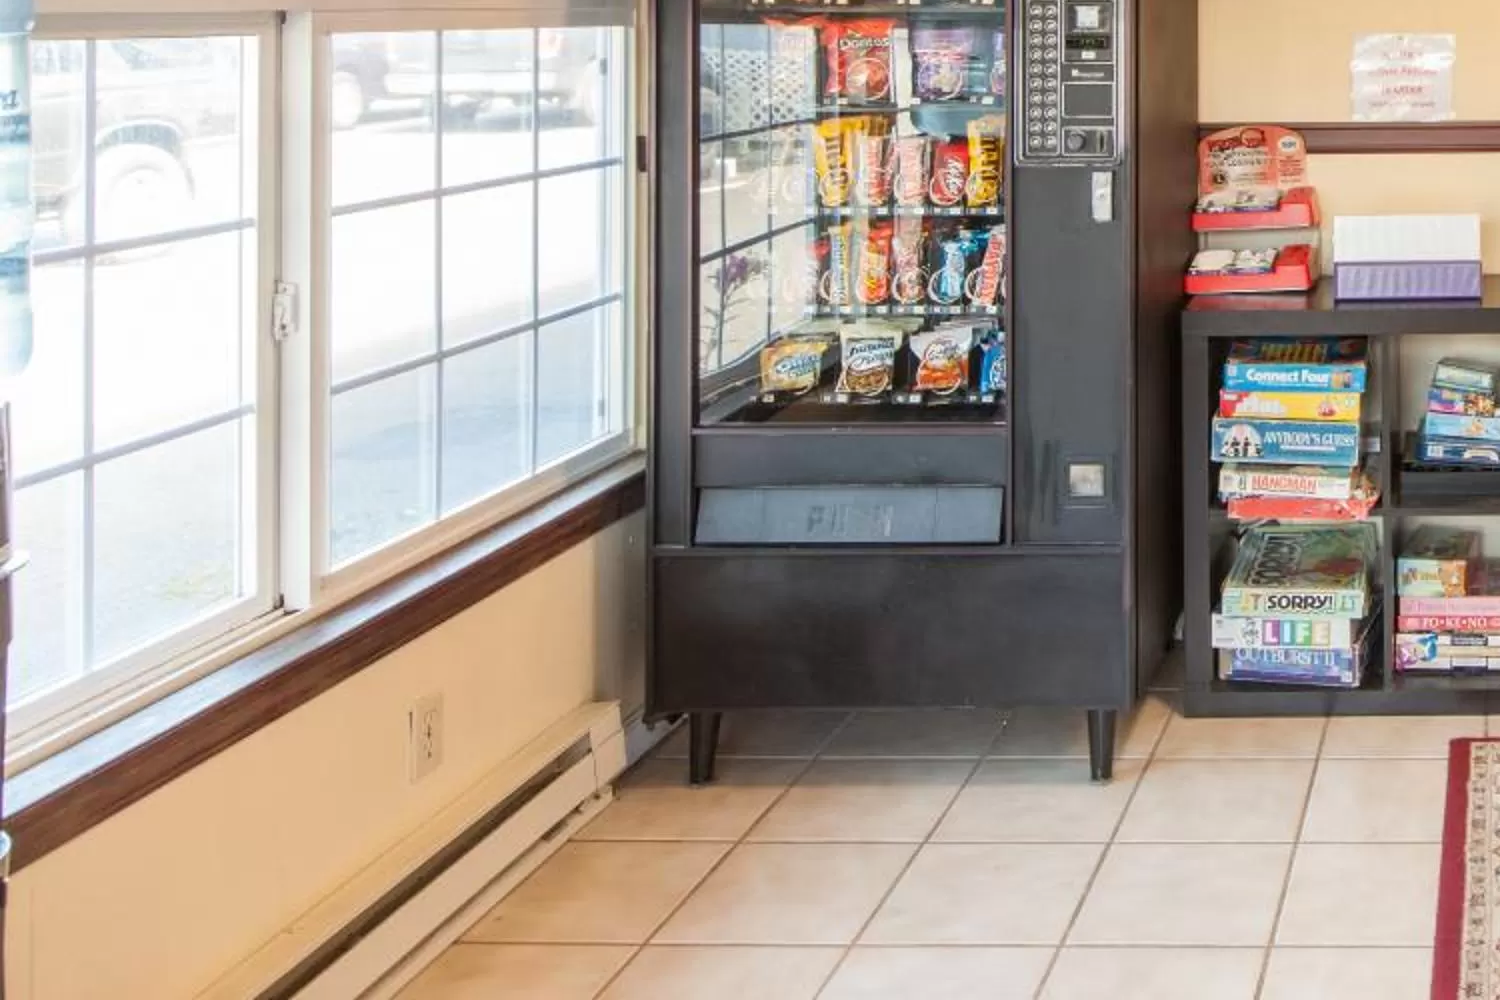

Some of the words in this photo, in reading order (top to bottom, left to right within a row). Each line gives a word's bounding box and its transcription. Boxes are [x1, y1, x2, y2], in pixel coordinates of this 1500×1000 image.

[1246, 368, 1299, 382] Connect
[1301, 369, 1329, 383] Four
[1264, 432, 1320, 446] ANYBODY'S
[1322, 434, 1355, 447] GUESS
[1252, 475, 1317, 493] HANGMAN
[806, 504, 894, 537] PUH
[1267, 595, 1333, 609] SORRY!
[1262, 620, 1330, 646] LIFE
[1236, 649, 1320, 665] OUTBURST
